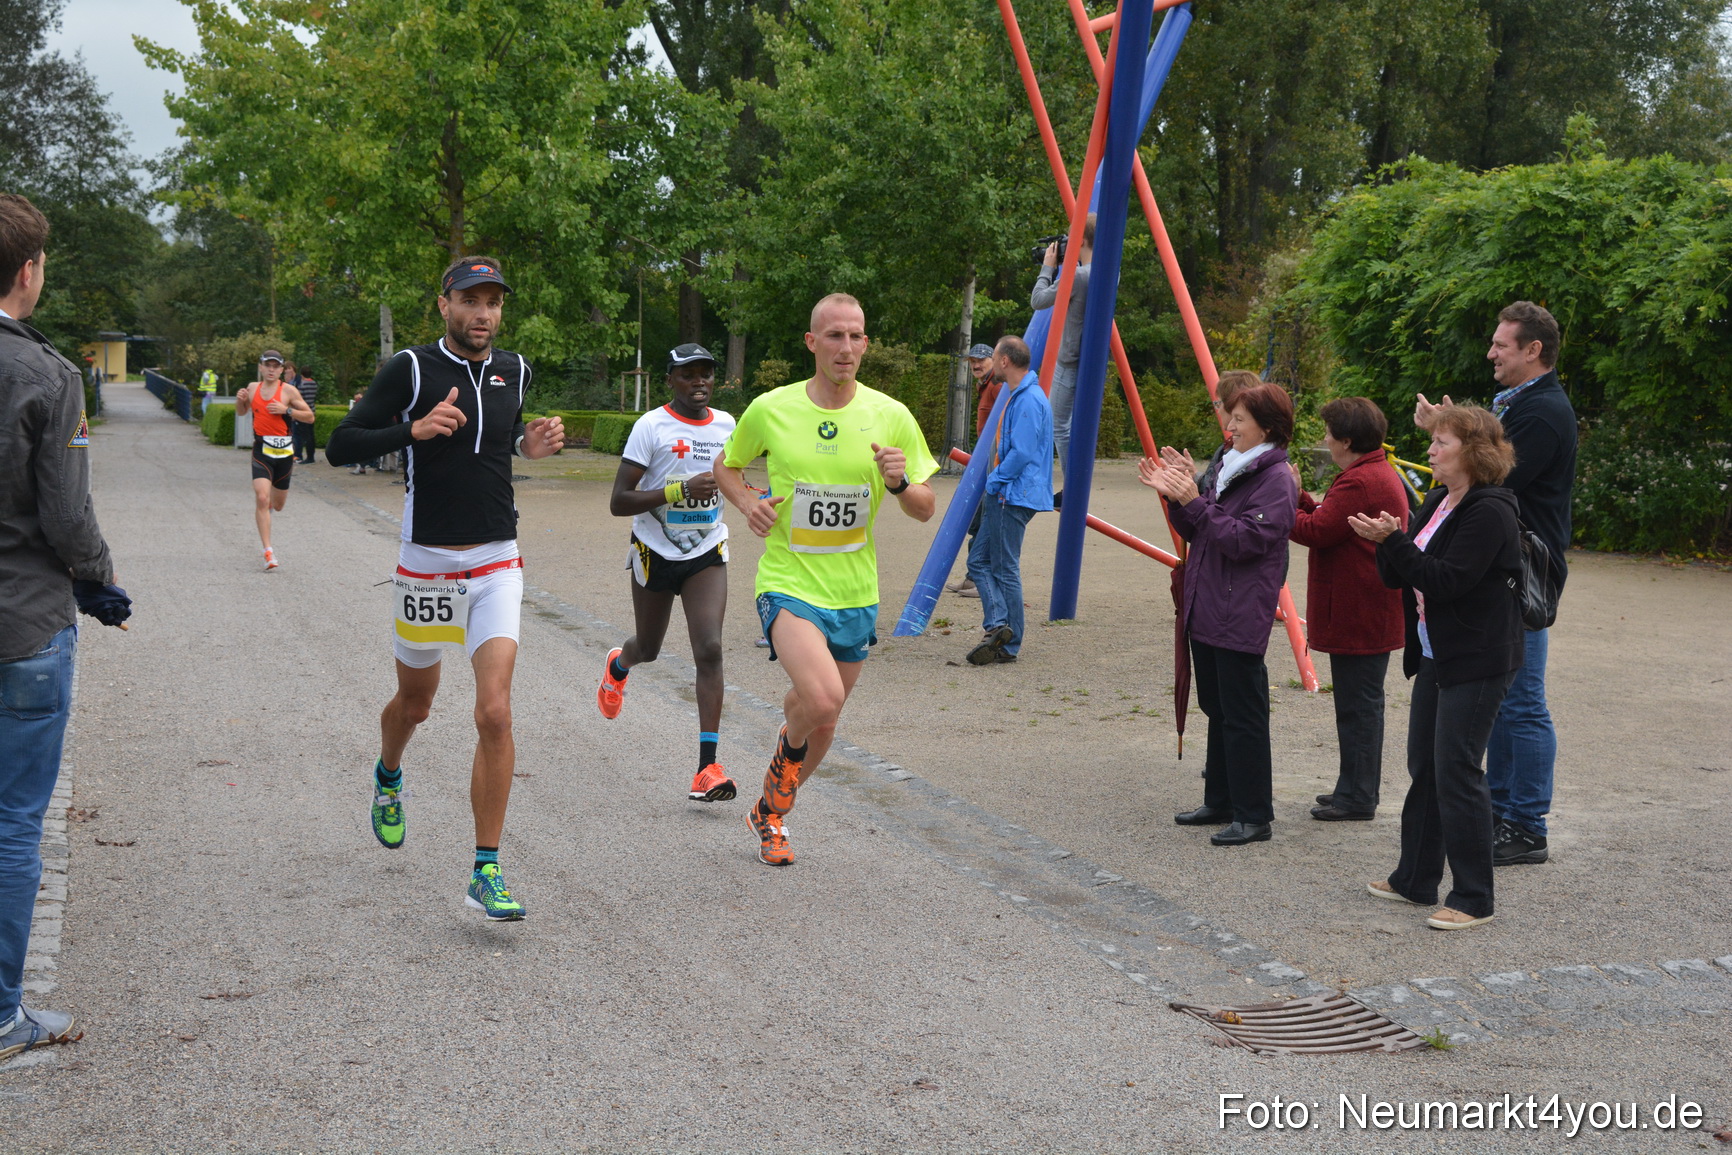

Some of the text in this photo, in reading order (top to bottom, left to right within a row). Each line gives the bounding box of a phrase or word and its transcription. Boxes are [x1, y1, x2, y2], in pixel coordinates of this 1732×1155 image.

[273, 438, 286, 448] 56
[815, 442, 838, 451] Partl
[795, 487, 861, 499] PARTL Neumarkt
[808, 501, 857, 527] 635
[413, 585, 455, 594] Neumarkt
[403, 594, 453, 623] 655
